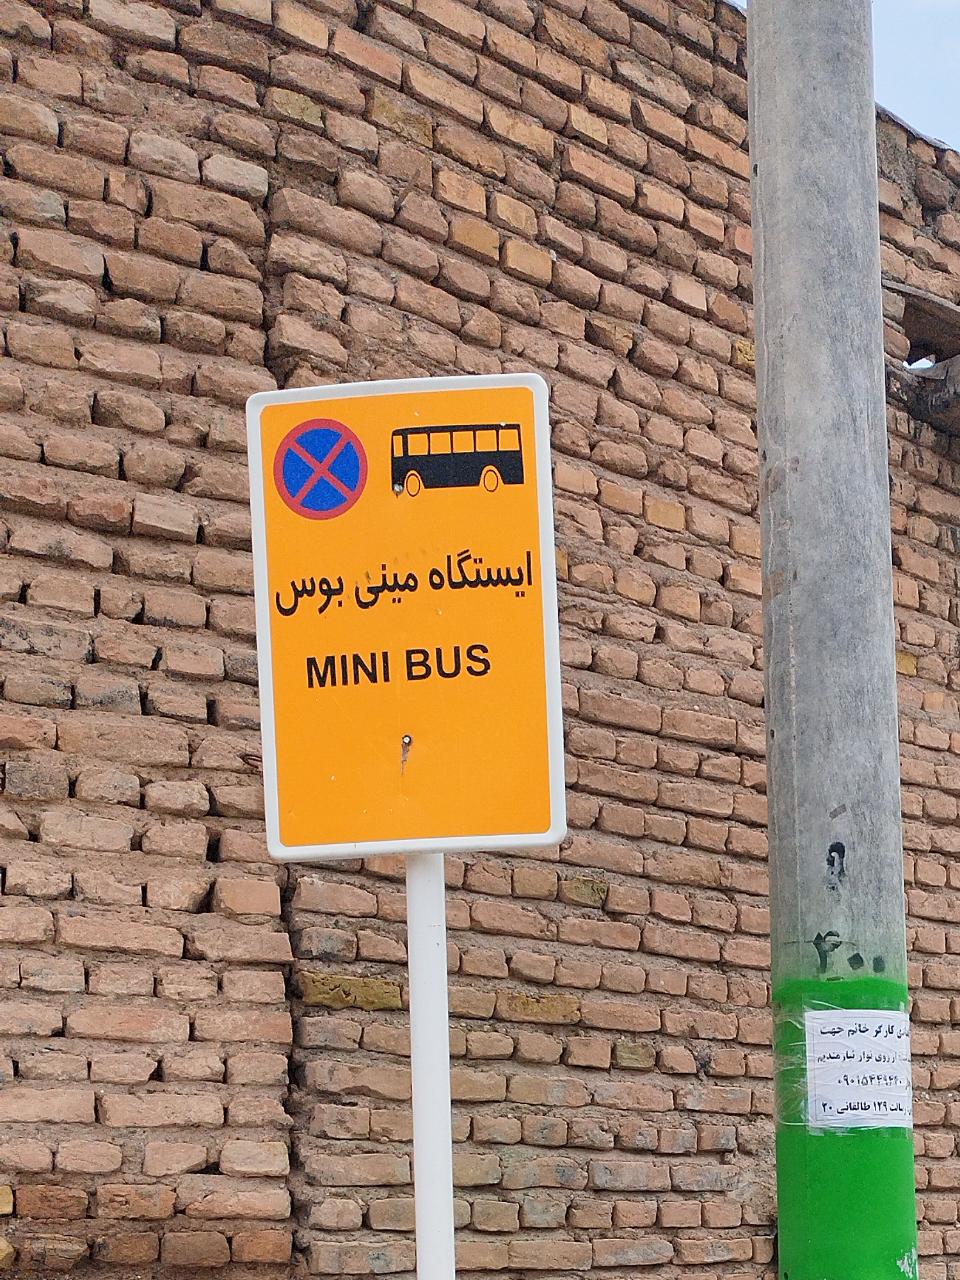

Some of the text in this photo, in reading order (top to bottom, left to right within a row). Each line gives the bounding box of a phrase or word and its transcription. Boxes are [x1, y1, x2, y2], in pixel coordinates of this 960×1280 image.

[275, 549, 532, 616] ایستگاه مینی بوس
[306, 644, 491, 688] MINI BUS
[847, 1023, 869, 1037] خانم
[837, 1101, 871, 1114] طالقانی
